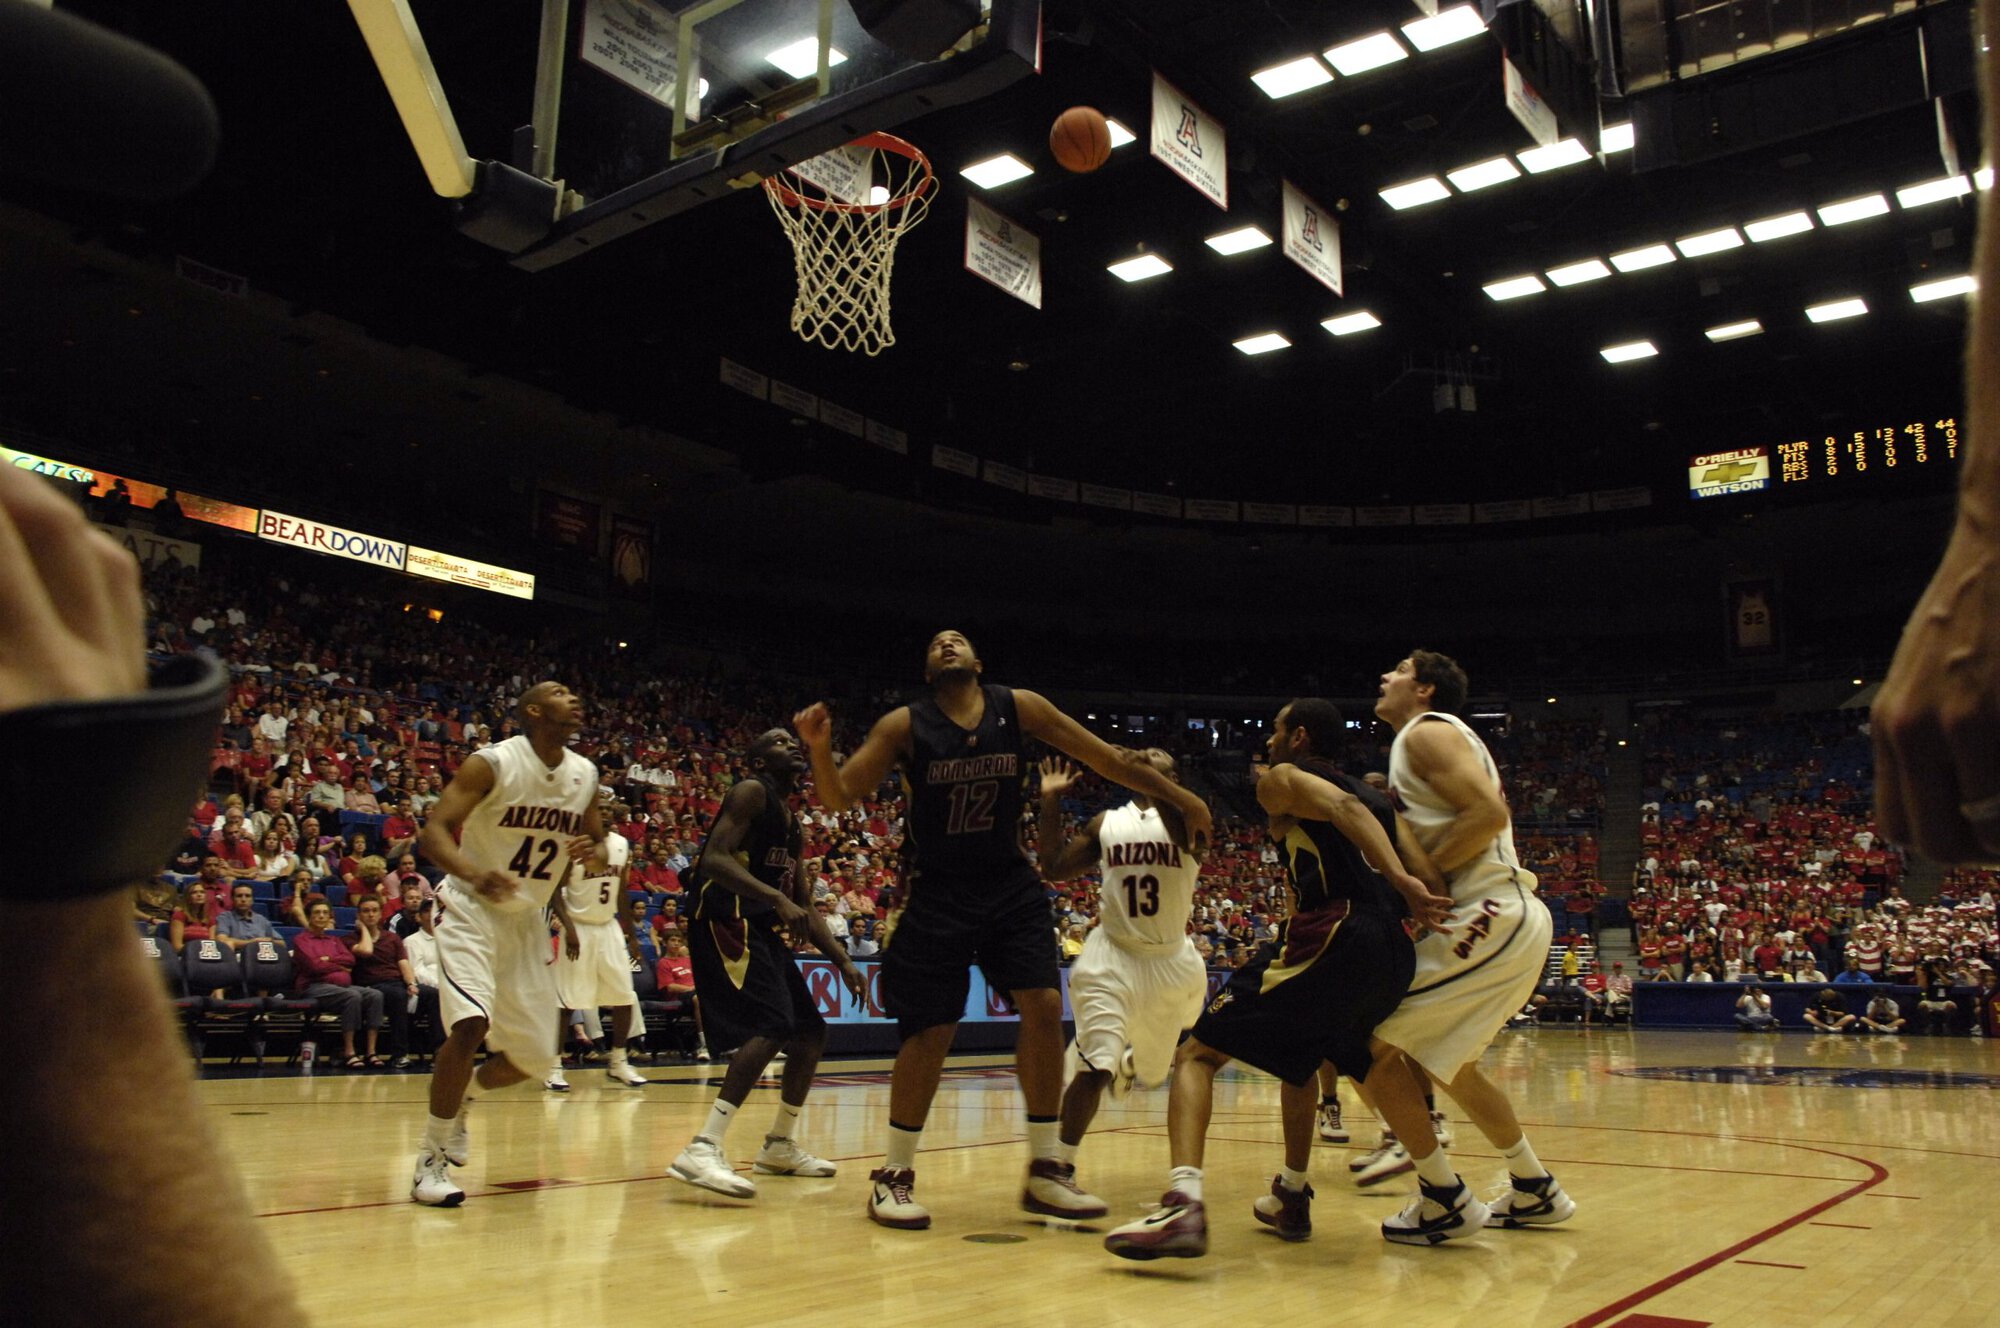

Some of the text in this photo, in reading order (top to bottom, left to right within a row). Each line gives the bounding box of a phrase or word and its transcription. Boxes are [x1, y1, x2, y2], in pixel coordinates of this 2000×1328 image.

[1778, 441, 1809, 454] PLYR
[1825, 436, 1835, 446] 0
[1904, 423, 1924, 434] 42
[1935, 418, 1955, 429] 44
[1695, 447, 1761, 466] O'RIELLY
[1783, 451, 1805, 463] PTS
[1783, 461, 1808, 473] RBS
[1783, 471, 1808, 482] FLS
[1827, 466, 1838, 475] 0
[1856, 461, 1867, 471] 0
[1886, 457, 1896, 467] 0
[1916, 453, 1927, 462] 0
[1697, 480, 1764, 498] WATSON
[1743, 611, 1764, 625] 32
[946, 780, 999, 836] 12
[497, 805, 584, 836] ARIZONA
[508, 835, 558, 881] 42
[599, 882, 611, 905] 5
[1123, 874, 1159, 917] 13
[1453, 899, 1500, 959] CATS
[199, 939, 222, 960] A
[257, 941, 279, 961] A
